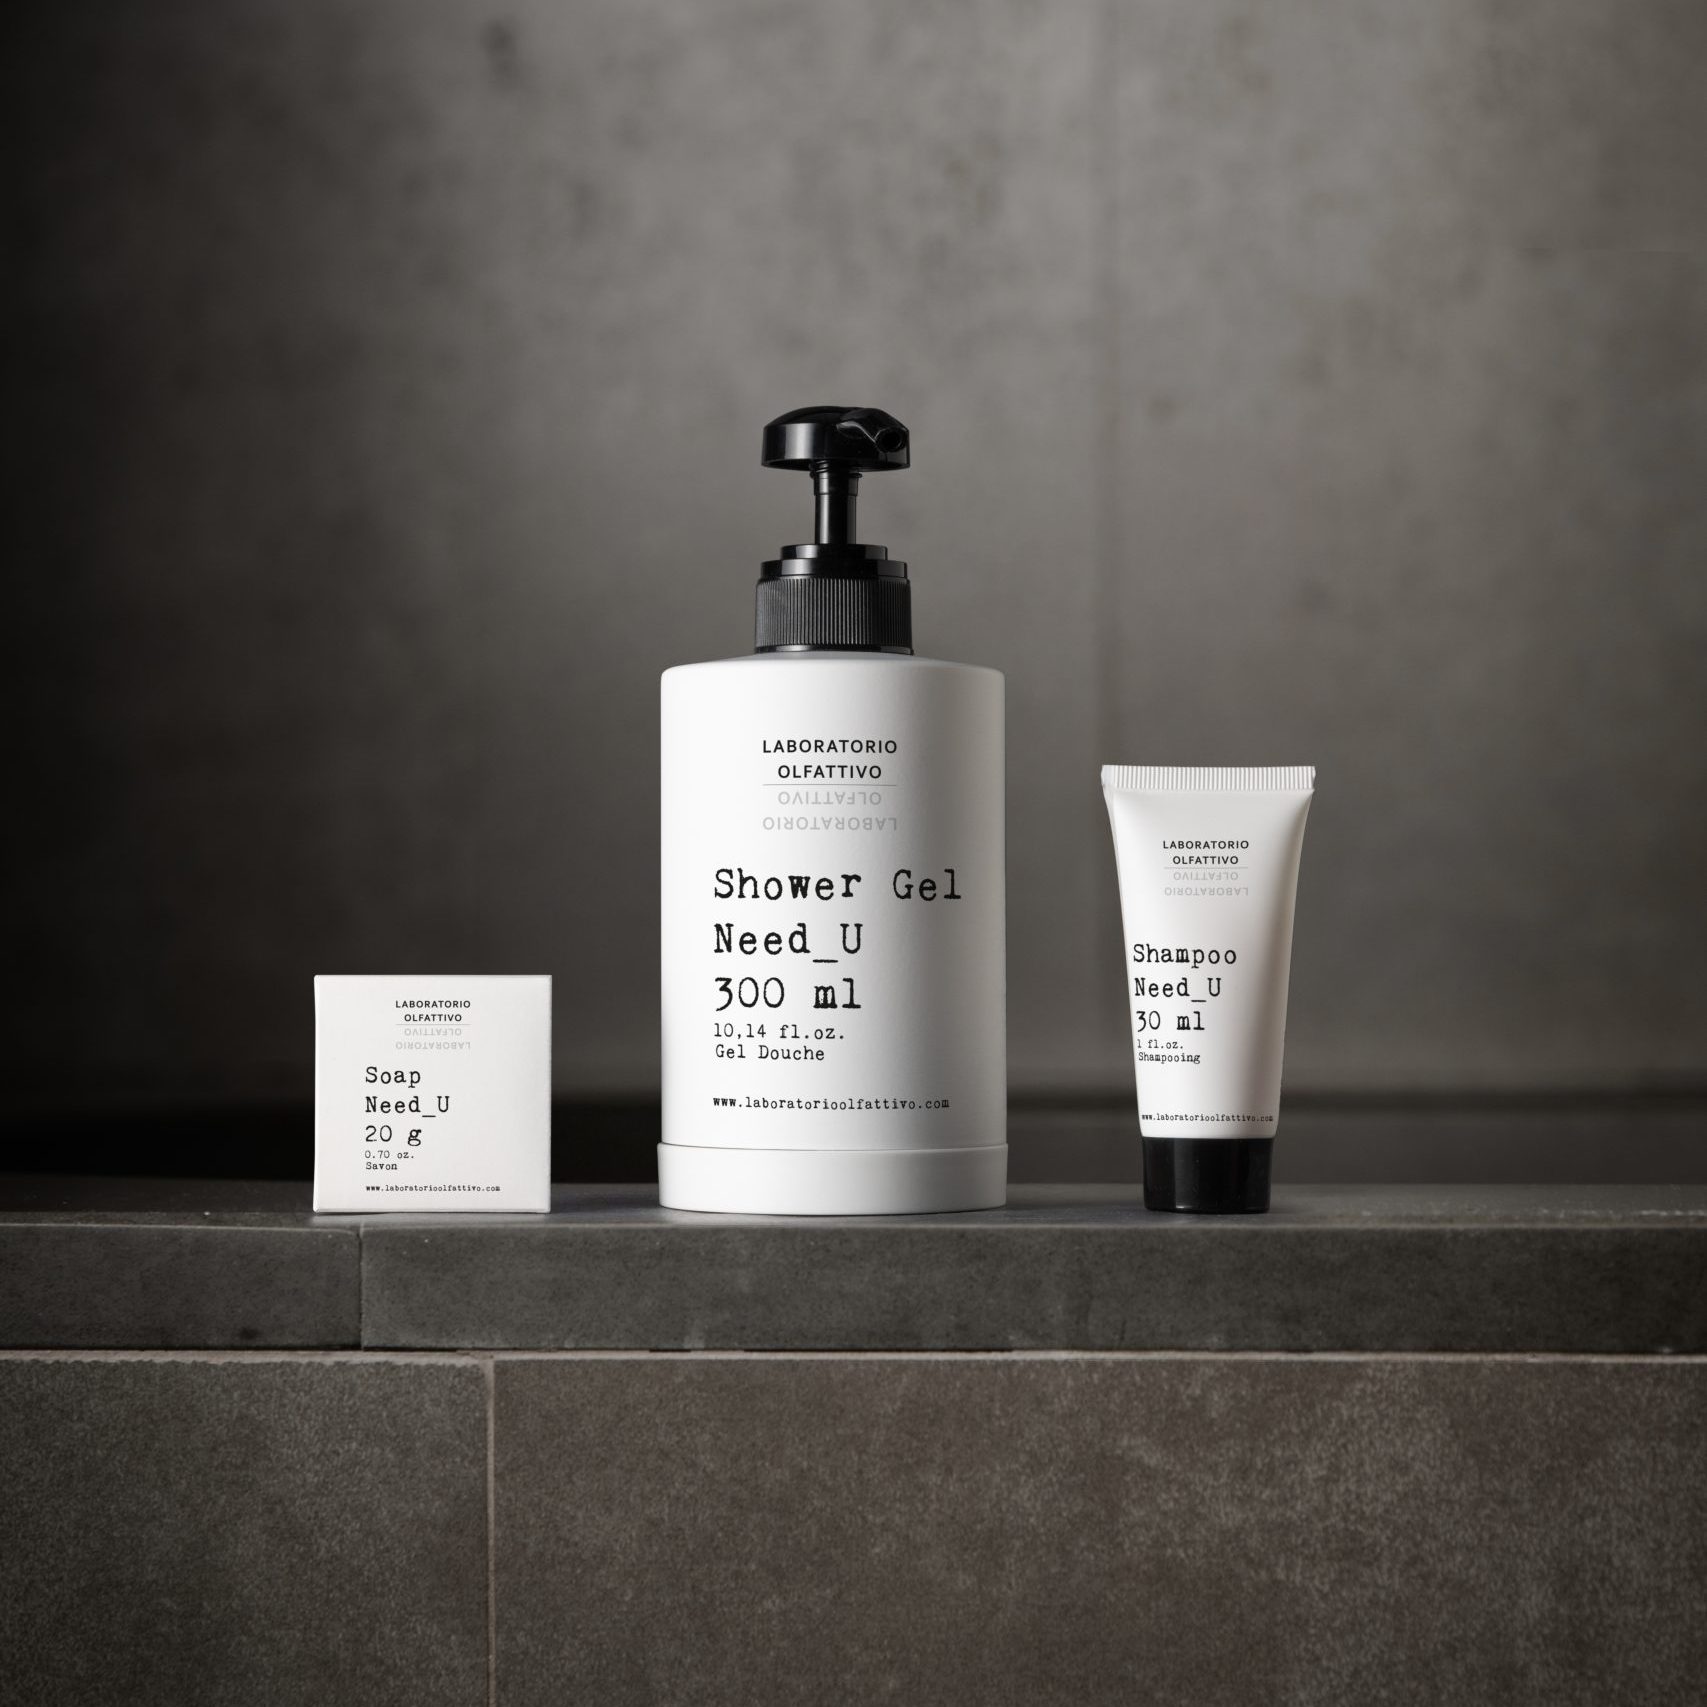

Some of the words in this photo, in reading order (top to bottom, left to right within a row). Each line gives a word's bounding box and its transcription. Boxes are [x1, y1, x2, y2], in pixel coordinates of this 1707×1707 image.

[763, 739, 897, 753] LABORATORIO
[778, 765, 881, 779] OLFATTIVO
[1163, 841, 1249, 849] LABORATORIO
[1173, 856, 1238, 864] OLFATTIVO
[715, 868, 861, 901] Shower
[893, 869, 961, 901] Gel
[714, 923, 863, 963] Need_U
[1133, 944, 1236, 969] Shampoo
[715, 977, 784, 1011] 300
[813, 978, 861, 1009] ml
[1135, 977, 1221, 1002] Need_U
[404, 1014, 462, 1022] OLFATTIVO
[1136, 1011, 1160, 1032] 30
[1177, 1011, 1205, 1030] ml
[714, 1023, 766, 1039] 10,14
[780, 1024, 843, 1040] fl.oz.
[1148, 1039, 1183, 1049] fl.oz.
[716, 1044, 745, 1059] Gel
[758, 1045, 824, 1061] Douche
[1139, 1052, 1200, 1064] Shampooing
[366, 1066, 420, 1088] Soap
[365, 1096, 449, 1117] Need_U
[713, 1097, 949, 1110] www.laboratorioolfattivo.com
[1141, 1113, 1274, 1122] www.laboratorioolfattivo.com
[366, 1125, 392, 1142] 20
[408, 1129, 421, 1146] g
[365, 1150, 390, 1159] 0.70
[366, 1162, 397, 1170] Savon
[365, 1184, 501, 1192] www.laboratorioolfattivo.com
